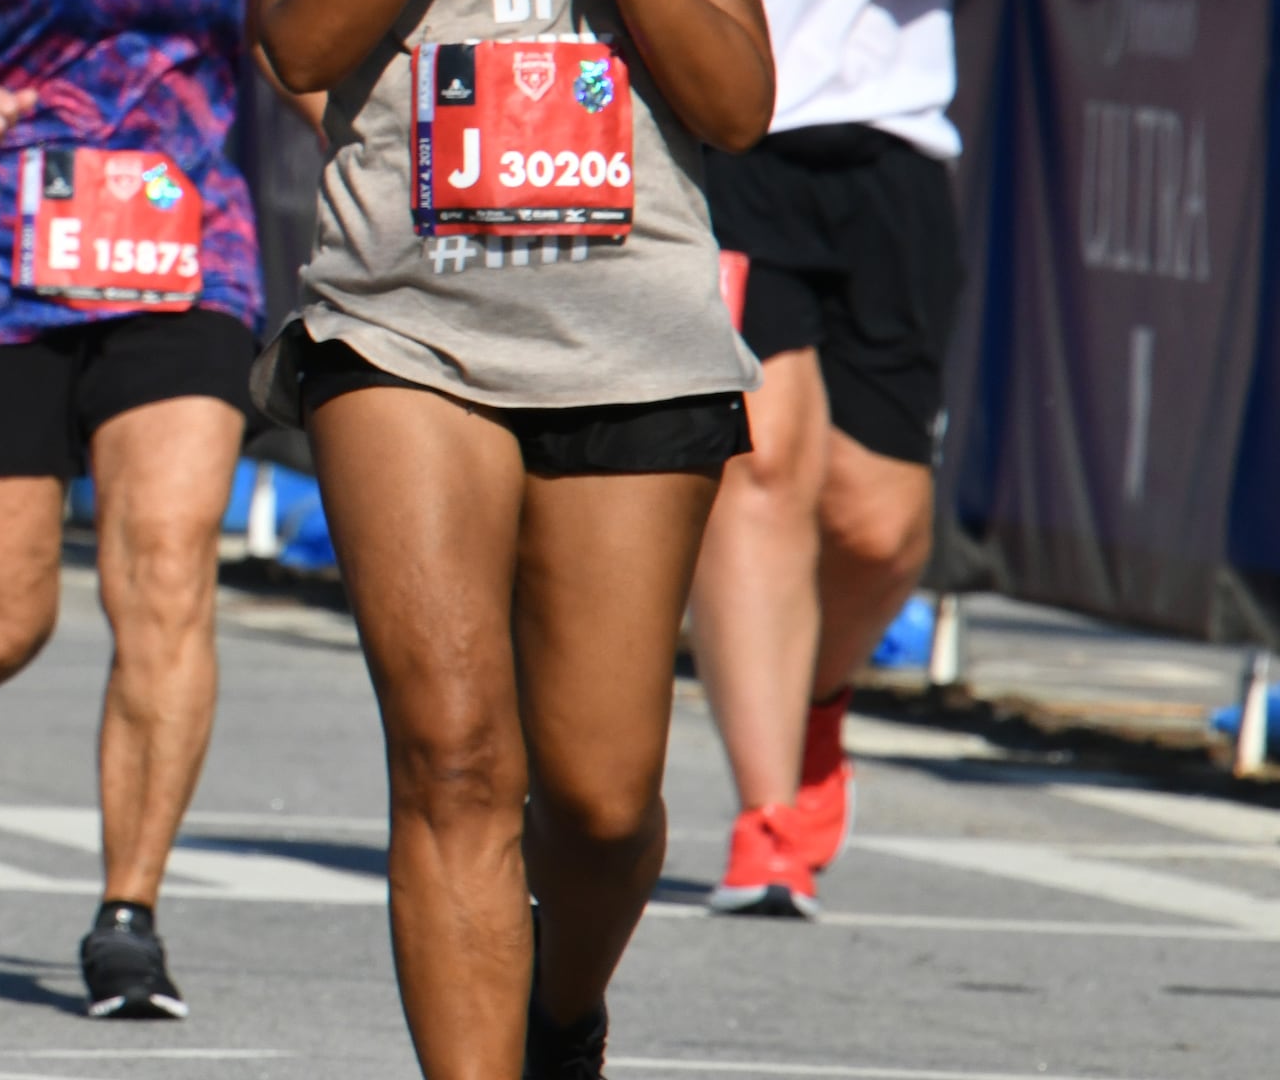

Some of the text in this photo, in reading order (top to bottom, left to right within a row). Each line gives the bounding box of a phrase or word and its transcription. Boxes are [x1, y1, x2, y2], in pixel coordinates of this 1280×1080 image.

[448, 128, 631, 189] J 30206
[1082, 98, 1210, 283] ULTRA
[49, 218, 81, 269] E
[94, 238, 199, 277] 15875
